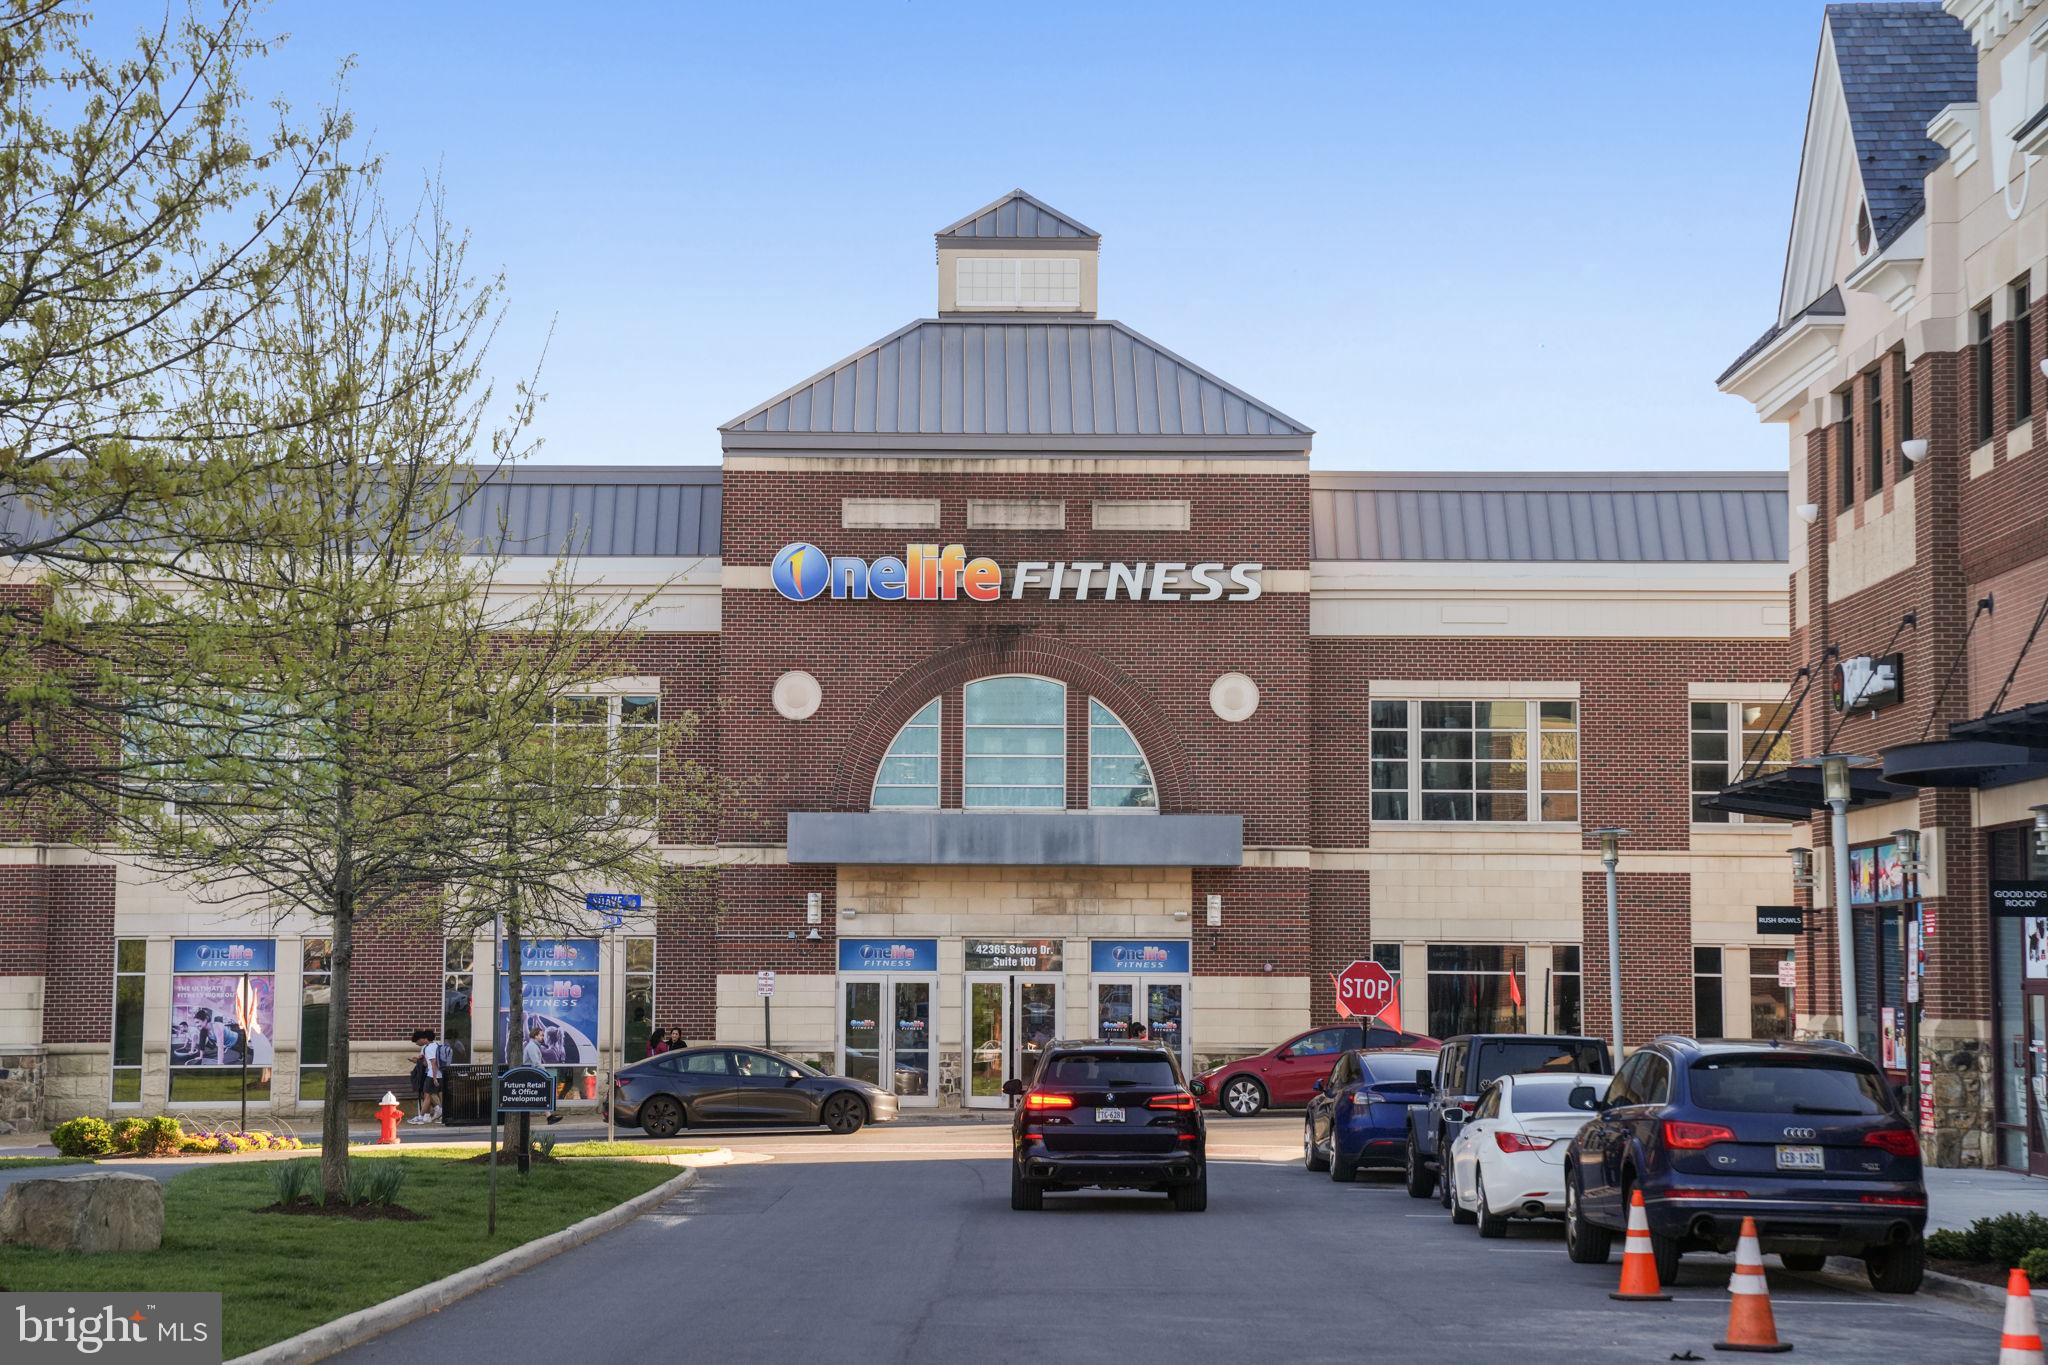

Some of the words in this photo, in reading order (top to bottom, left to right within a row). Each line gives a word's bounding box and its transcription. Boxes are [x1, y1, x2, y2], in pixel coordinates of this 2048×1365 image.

[771, 542, 1001, 601] Onelife
[1011, 561, 1263, 600] FITNESS
[1993, 890, 2023, 898] GOOD
[2025, 890, 2047, 898] DOG
[2005, 899, 2036, 907] ROCKY
[976, 944, 1007, 955] 42365
[1009, 944, 1038, 955] Soave
[1040, 945, 1054, 955] Dr.
[993, 956, 1018, 967] Suite
[1019, 957, 1037, 967] 100
[1342, 977, 1389, 1000] STOP
[522, 999, 577, 1007] FITNESS
[504, 1081, 526, 1089] Future
[527, 1081, 546, 1089] Retail
[518, 1088, 539, 1096] Office
[502, 1095, 547, 1104] Development
